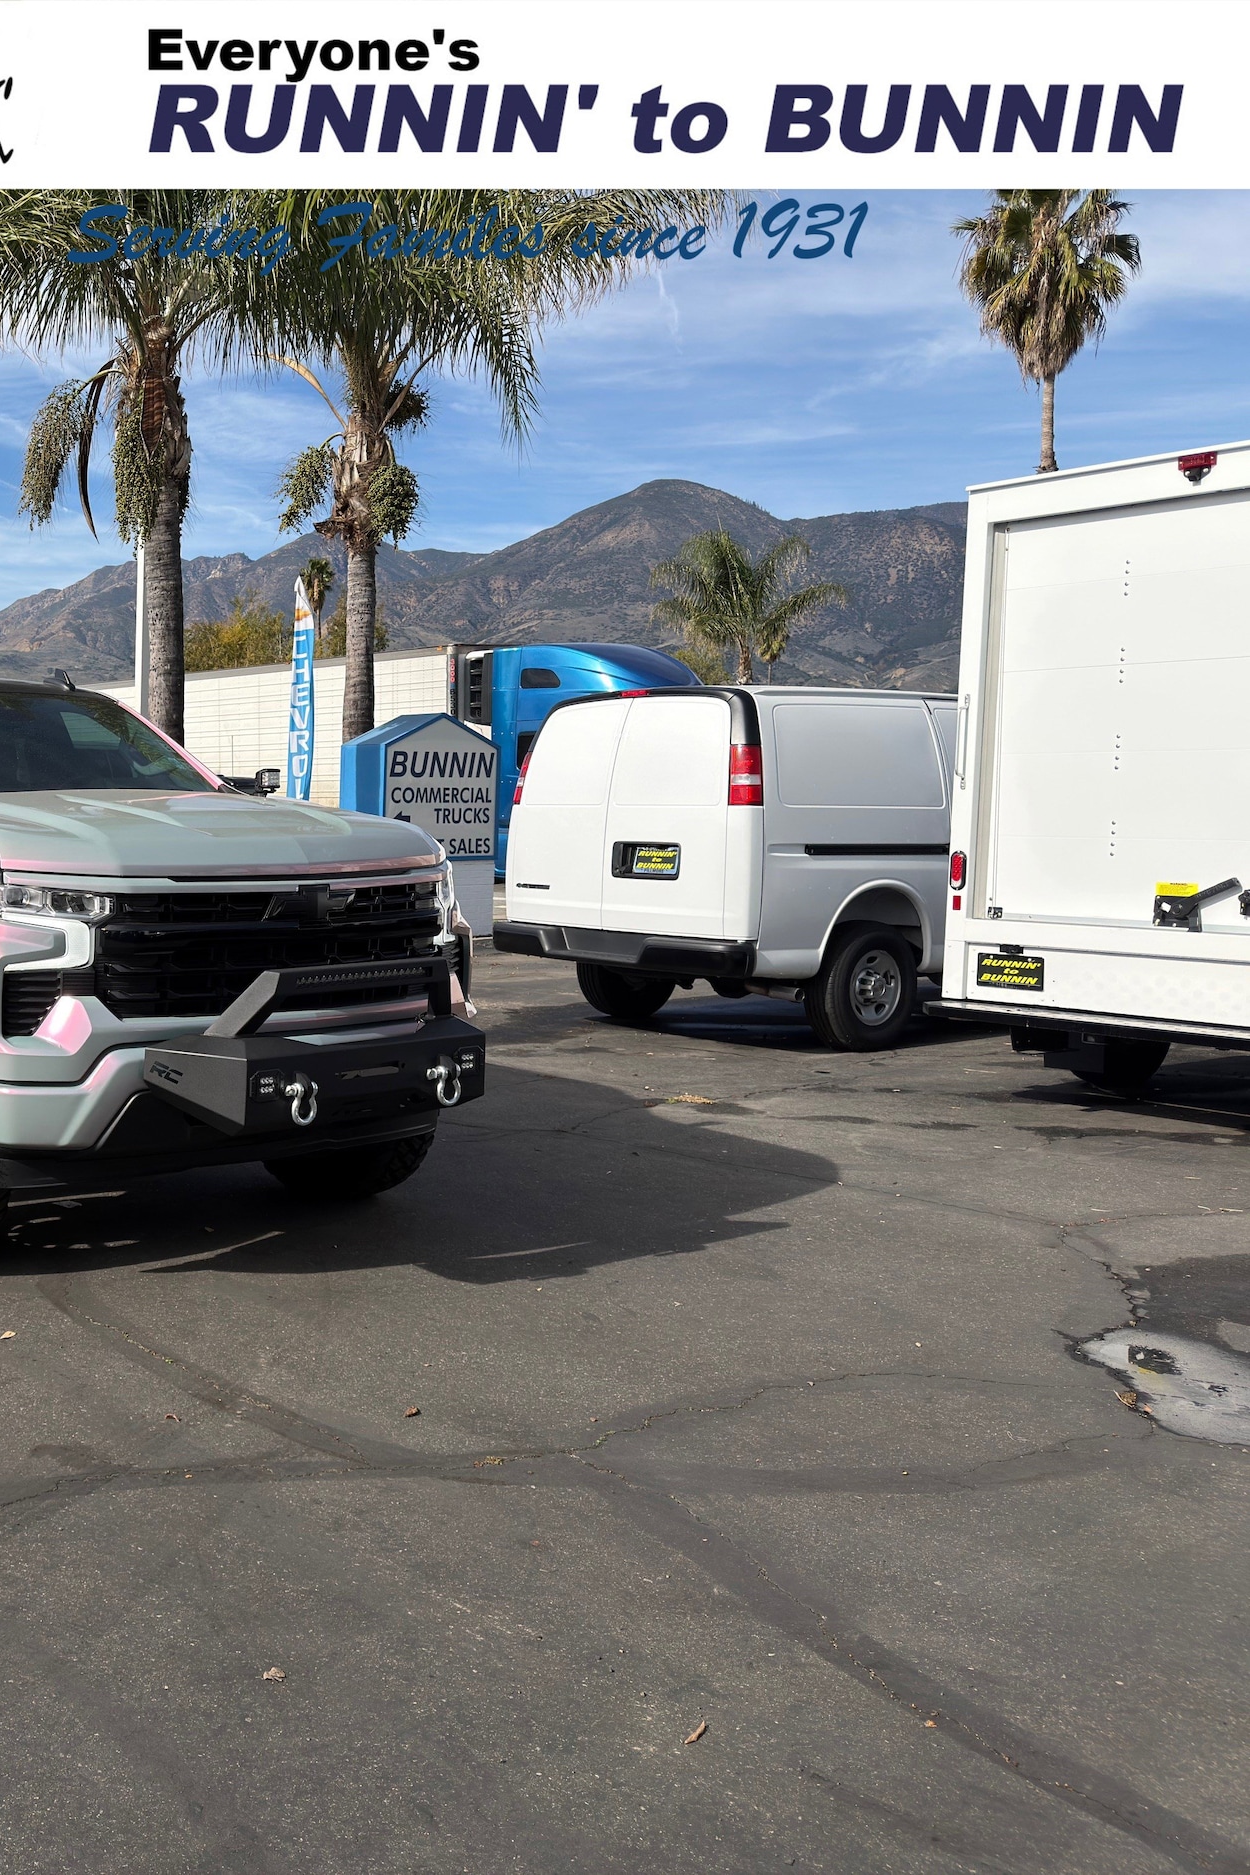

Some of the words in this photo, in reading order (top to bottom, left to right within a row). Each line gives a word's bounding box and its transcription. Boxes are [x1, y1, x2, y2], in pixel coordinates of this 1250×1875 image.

[389, 751, 495, 778] BUNNIN
[391, 786, 492, 804] COMMERCIAL
[434, 807, 490, 824] TRUCKS
[449, 838, 491, 855] SALES
[981, 959, 1042, 969] RUNNIN'
[980, 973, 1039, 985] BUNNIN
[150, 1060, 183, 1085] RC
